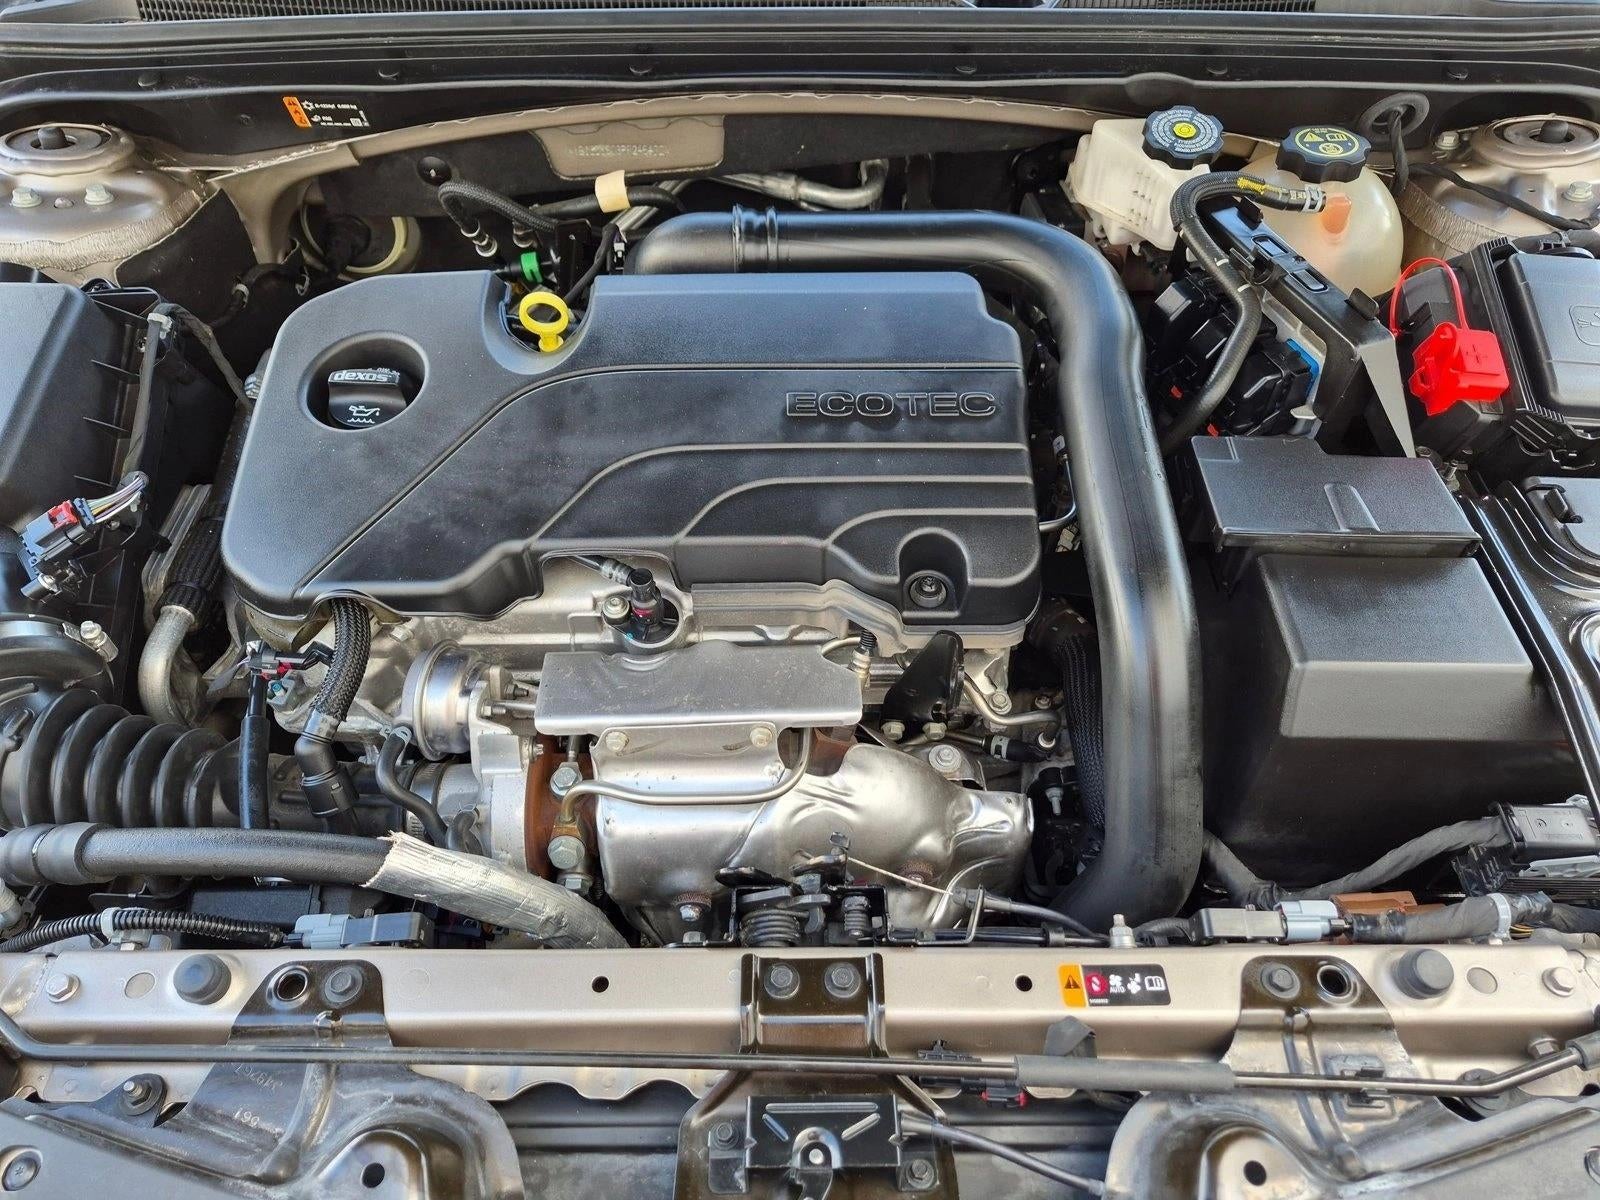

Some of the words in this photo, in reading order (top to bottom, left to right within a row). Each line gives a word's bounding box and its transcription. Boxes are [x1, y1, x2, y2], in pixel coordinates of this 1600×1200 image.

[333, 370, 388, 382] dexos
[785, 391, 996, 417] ECOTEC
[1109, 985, 1126, 993] AUTO
